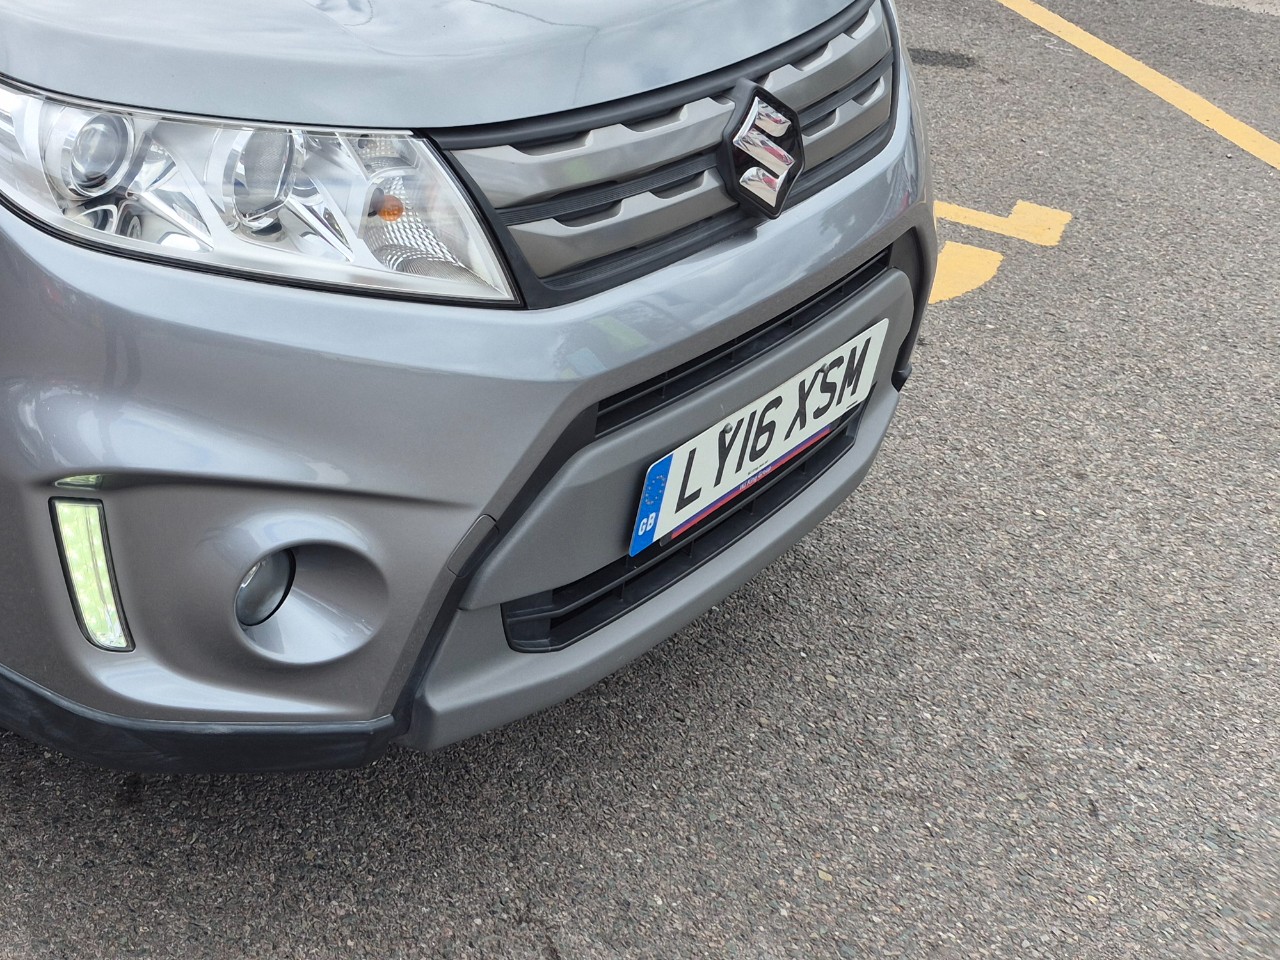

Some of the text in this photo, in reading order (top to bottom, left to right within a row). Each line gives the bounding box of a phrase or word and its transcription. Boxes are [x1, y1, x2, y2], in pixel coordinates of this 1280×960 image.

[675, 337, 872, 515] LY16 XSM
[638, 512, 655, 537] GB
